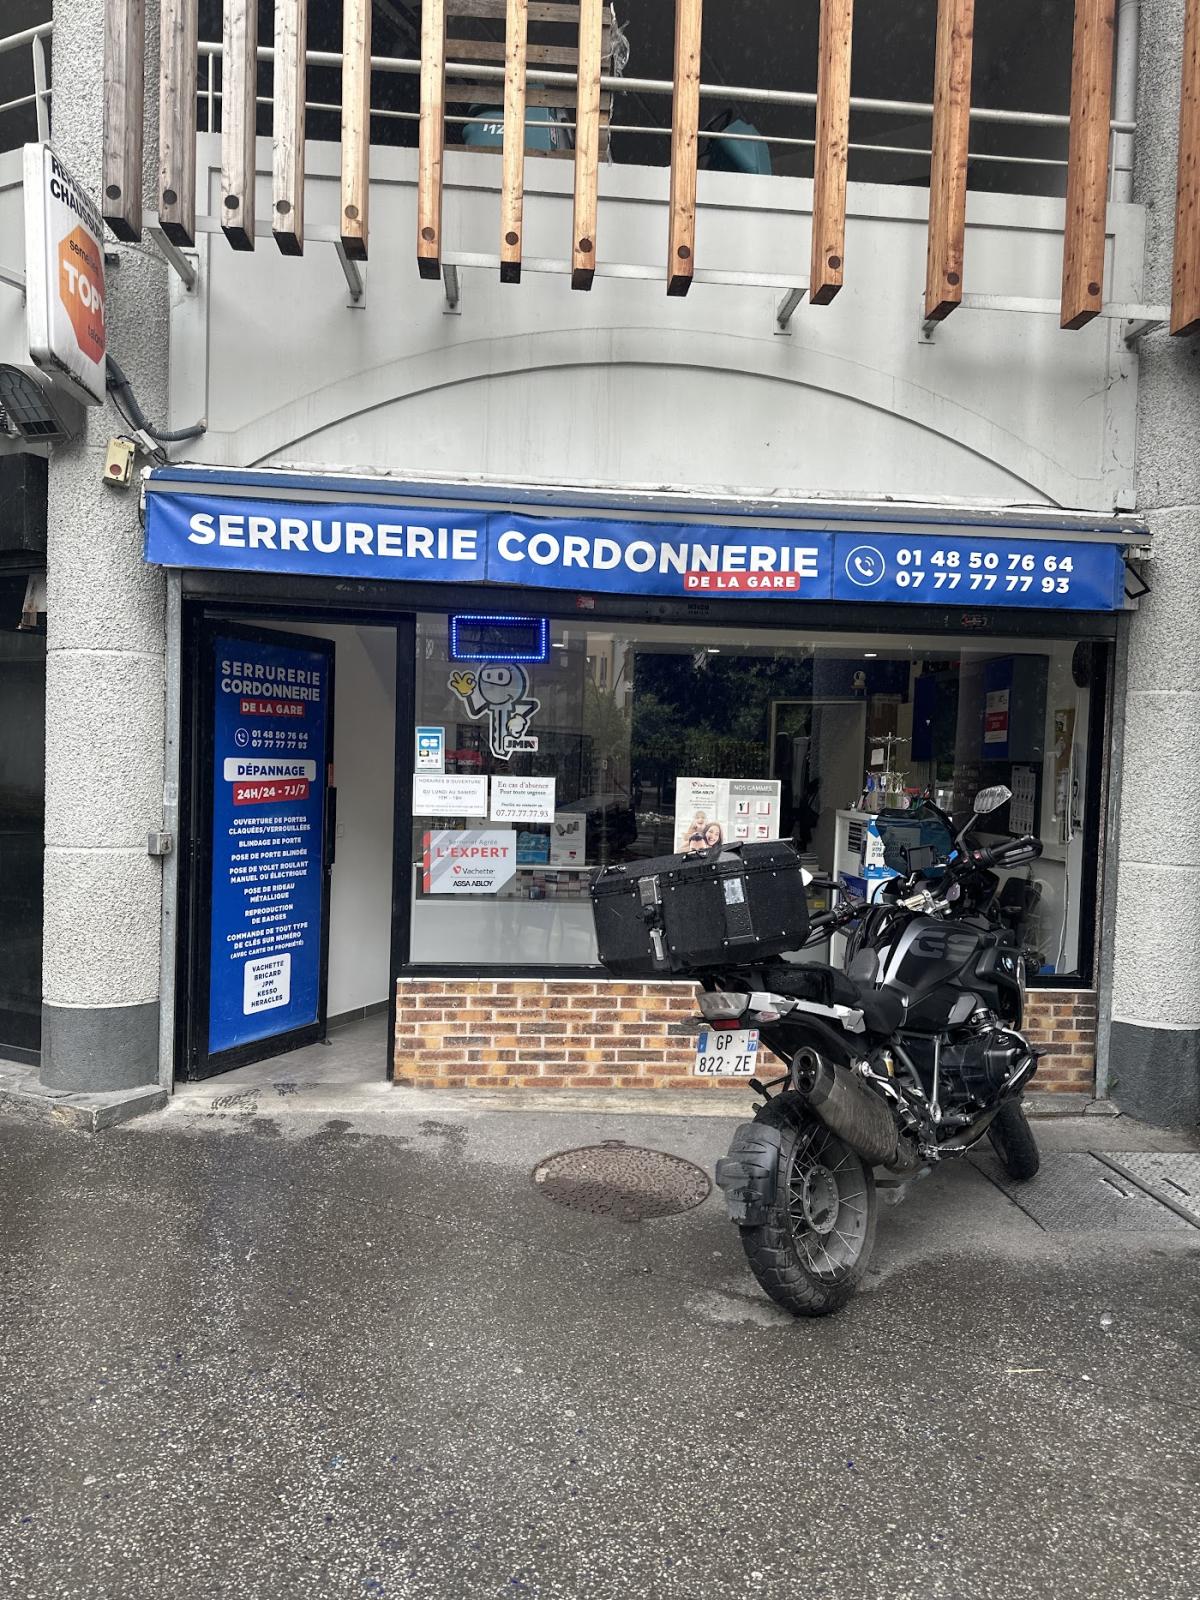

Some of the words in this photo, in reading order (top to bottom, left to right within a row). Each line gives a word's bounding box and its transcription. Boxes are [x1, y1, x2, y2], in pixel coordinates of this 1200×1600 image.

[63, 260, 104, 326] TOPY
[188, 513, 478, 560] SERRURERIE
[497, 530, 818, 577] CORDONNERIE
[896, 549, 922, 566] 01
[930, 551, 960, 567] 48
[968, 552, 999, 569] 50
[1007, 554, 1035, 571] 76
[1043, 556, 1073, 572] 64
[688, 576, 709, 588] DE
[718, 576, 739, 588] LA
[750, 577, 796, 588] GARE
[896, 571, 925, 587] 07
[933, 572, 961, 589] 77
[970, 574, 998, 590] 77
[1005, 575, 1033, 592] 77
[1041, 577, 1070, 594] 93
[221, 660, 320, 686] SERRURERIE
[221, 678, 320, 702] CORDONNERIE
[242, 702, 256, 712] DE
[260, 703, 273, 713] LA
[276, 704, 303, 715] GARE
[252, 730, 261, 738] 01
[263, 730, 273, 738] 48
[275, 731, 285, 739] 50
[252, 739, 262, 748] 07
[264, 740, 273, 748] 77
[287, 741, 296, 749] 77
[237, 763, 305, 776] DÉPANNAGE
[237, 787, 276, 800] 24H/24
[284, 783, 306, 797] 7J/7
[519, 781, 549, 789] d'absence
[496, 809, 549, 818] 07.77.77.77.93
[233, 818, 273, 826] OUVERTURE
[239, 839, 271, 848] BLINDAGE
[272, 838, 281, 846] DE
[281, 837, 302, 845] PORTE
[231, 853, 249, 861] POSE
[250, 852, 259, 860] DE
[260, 850, 281, 858] PORTE
[282, 848, 307, 857] BLINDÉE
[436, 847, 509, 858] L'EXPERT
[229, 866, 247, 875] POSE
[259, 864, 279, 872] VOLET
[280, 861, 309, 869] ROULANT
[462, 867, 495, 875] Vachette
[230, 875, 258, 884] MANUEL
[270, 869, 307, 879] ÉLECTRIQUE
[244, 888, 262, 896] POSE
[272, 883, 295, 892] RIDEAU
[250, 892, 290, 903] MÉTALLIQUE
[245, 904, 294, 917] REPRODUCTION
[252, 917, 261, 925] DE
[262, 913, 287, 923] BADGES
[227, 930, 265, 942] COMMANDE
[275, 925, 292, 933] TOUT
[293, 922, 309, 930] TYPE
[234, 942, 243, 950] DE
[244, 938, 261, 947] CLÉS
[262, 936, 275, 945] SUR
[276, 931, 302, 942] NUMÉRO
[230, 950, 248, 960] (AVEC
[249, 947, 266, 956] CARTE
[252, 960, 285, 973] VACHETTE
[254, 969, 282, 981] BRICARD
[262, 980, 274, 988] JPM
[257, 988, 278, 998] KESSO
[251, 995, 283, 1008] HERACLES
[716, 1034, 733, 1051] GP
